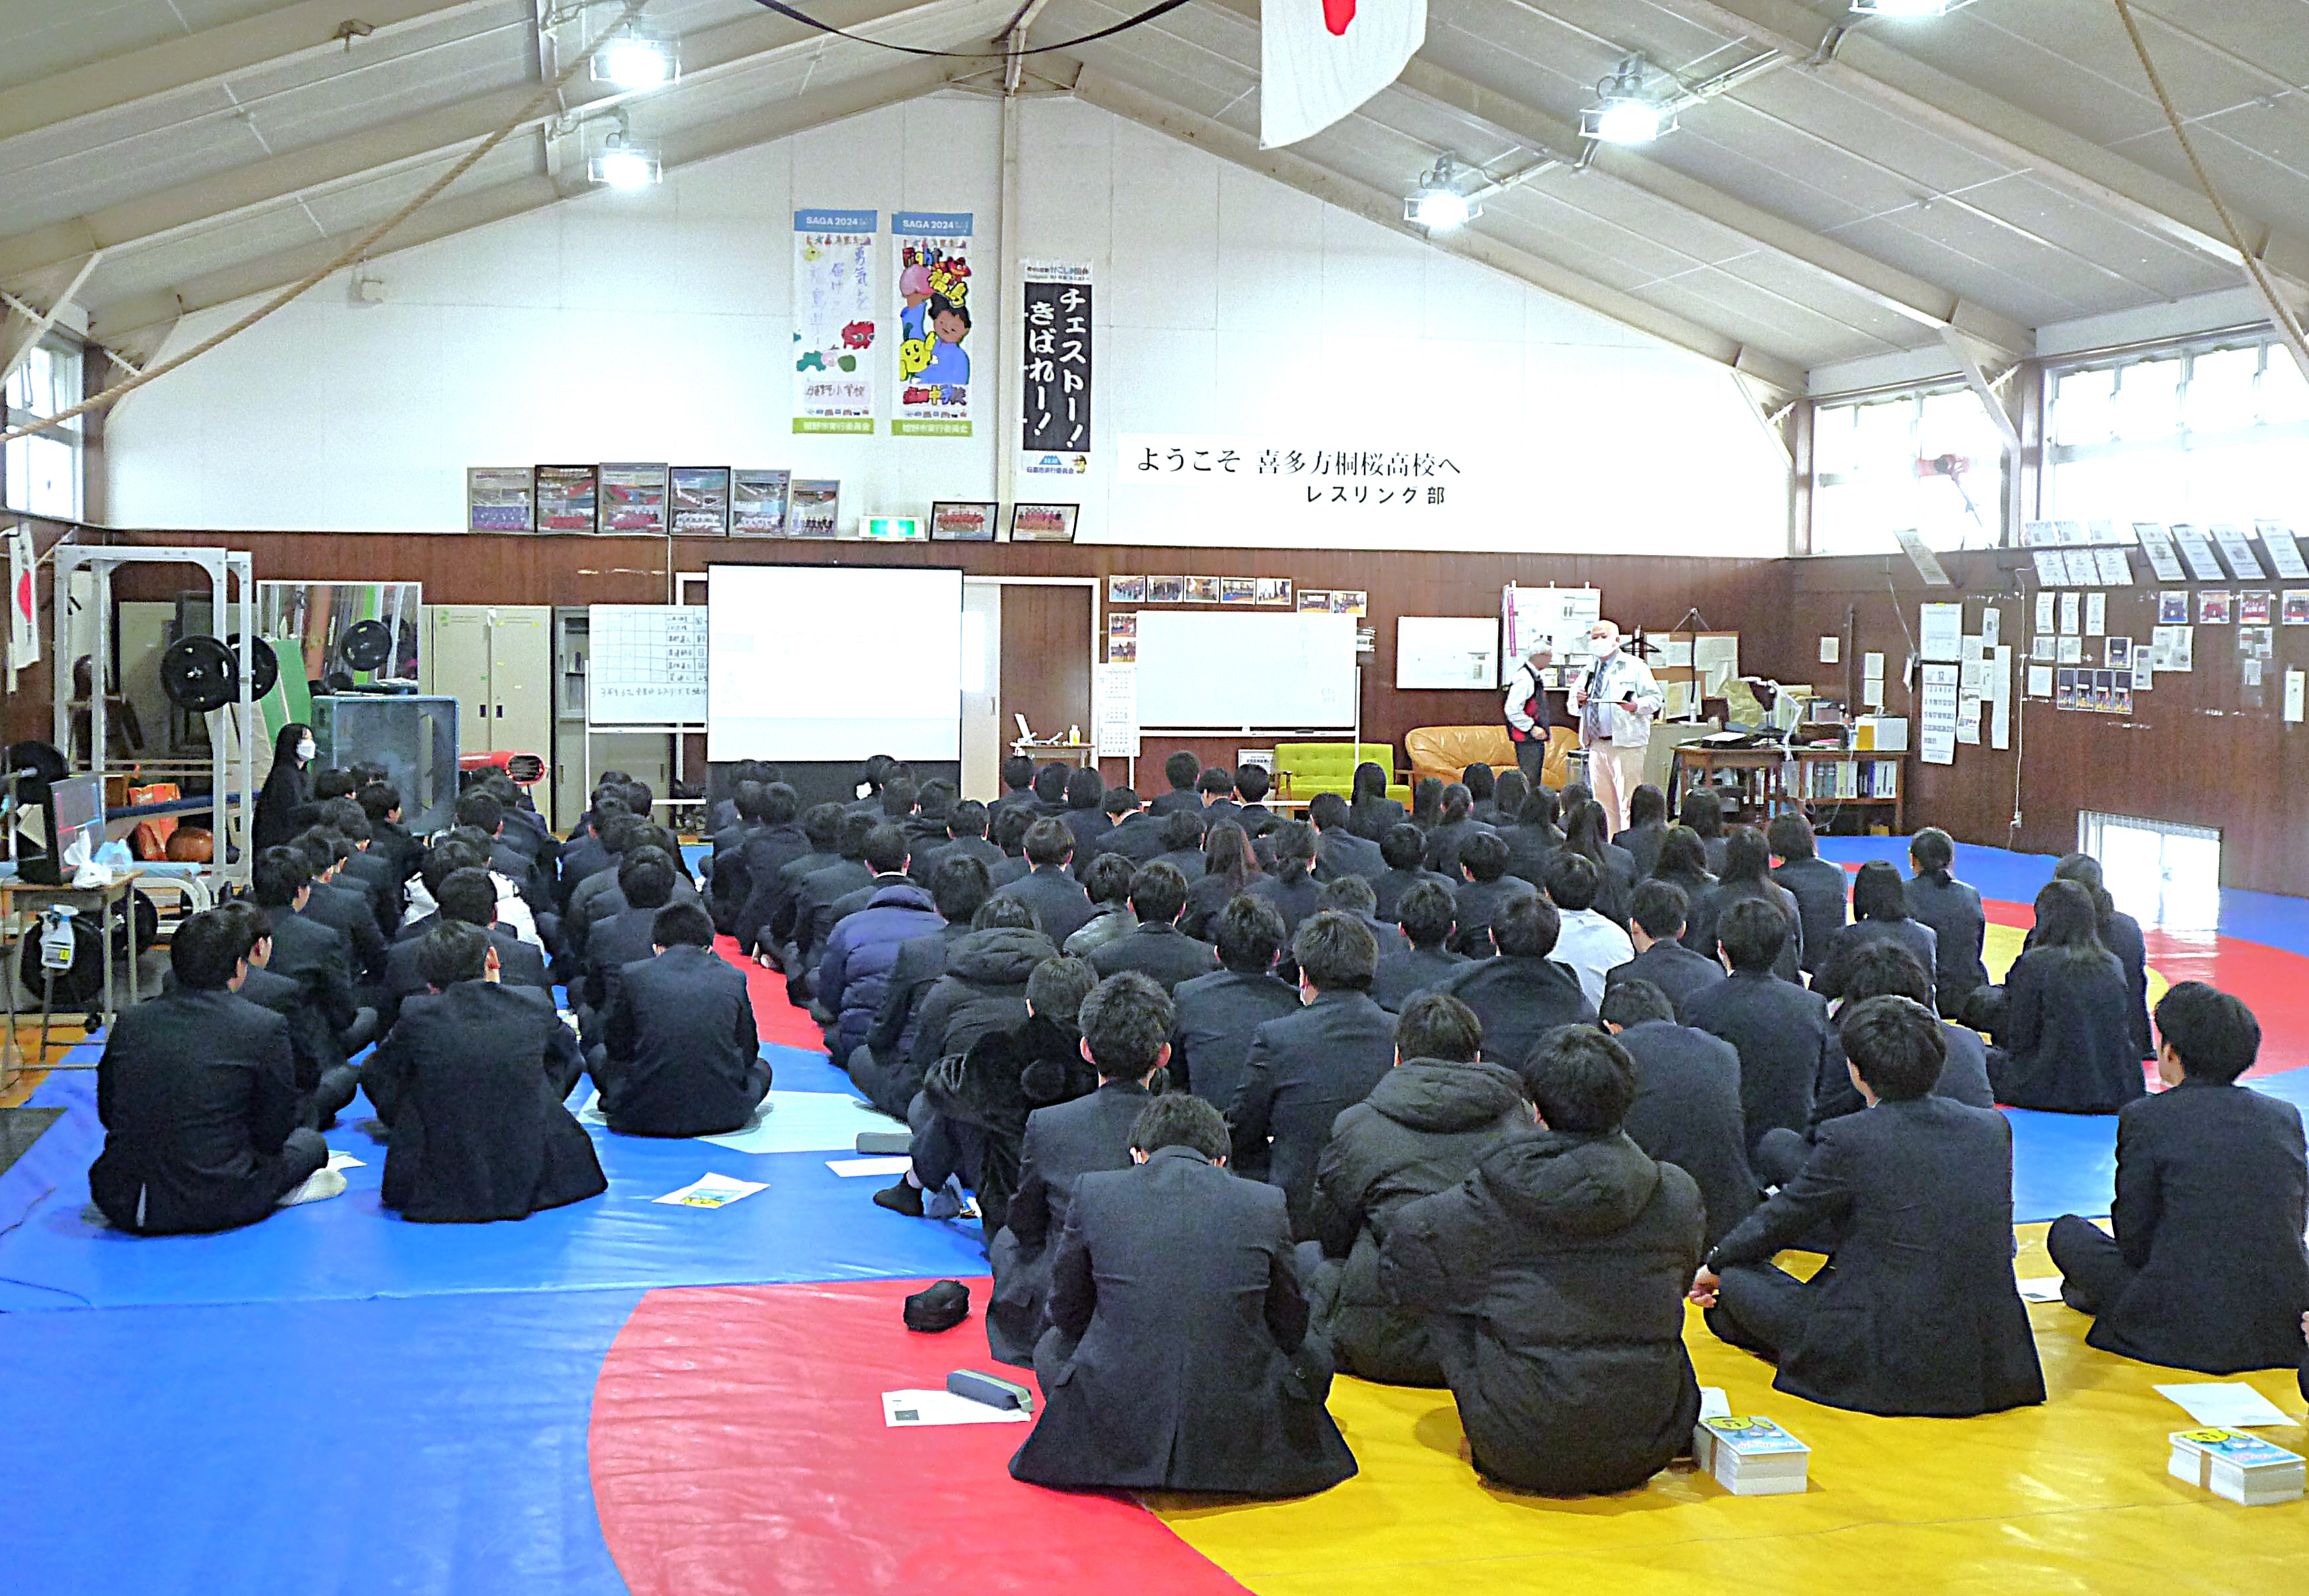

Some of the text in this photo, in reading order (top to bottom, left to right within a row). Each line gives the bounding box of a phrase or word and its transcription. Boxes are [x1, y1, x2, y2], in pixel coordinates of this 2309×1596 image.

[806, 216, 833, 226] SAGA
[835, 217, 858, 226] 2024
[903, 220, 929, 228] SAGA
[1029, 301, 1057, 437] きばれー！
[1059, 288, 1087, 448] チェストー！
[1138, 447, 1460, 478] ようこそ 喜多方桐桜高校へ
[1307, 485, 1445, 505] レスリング部
